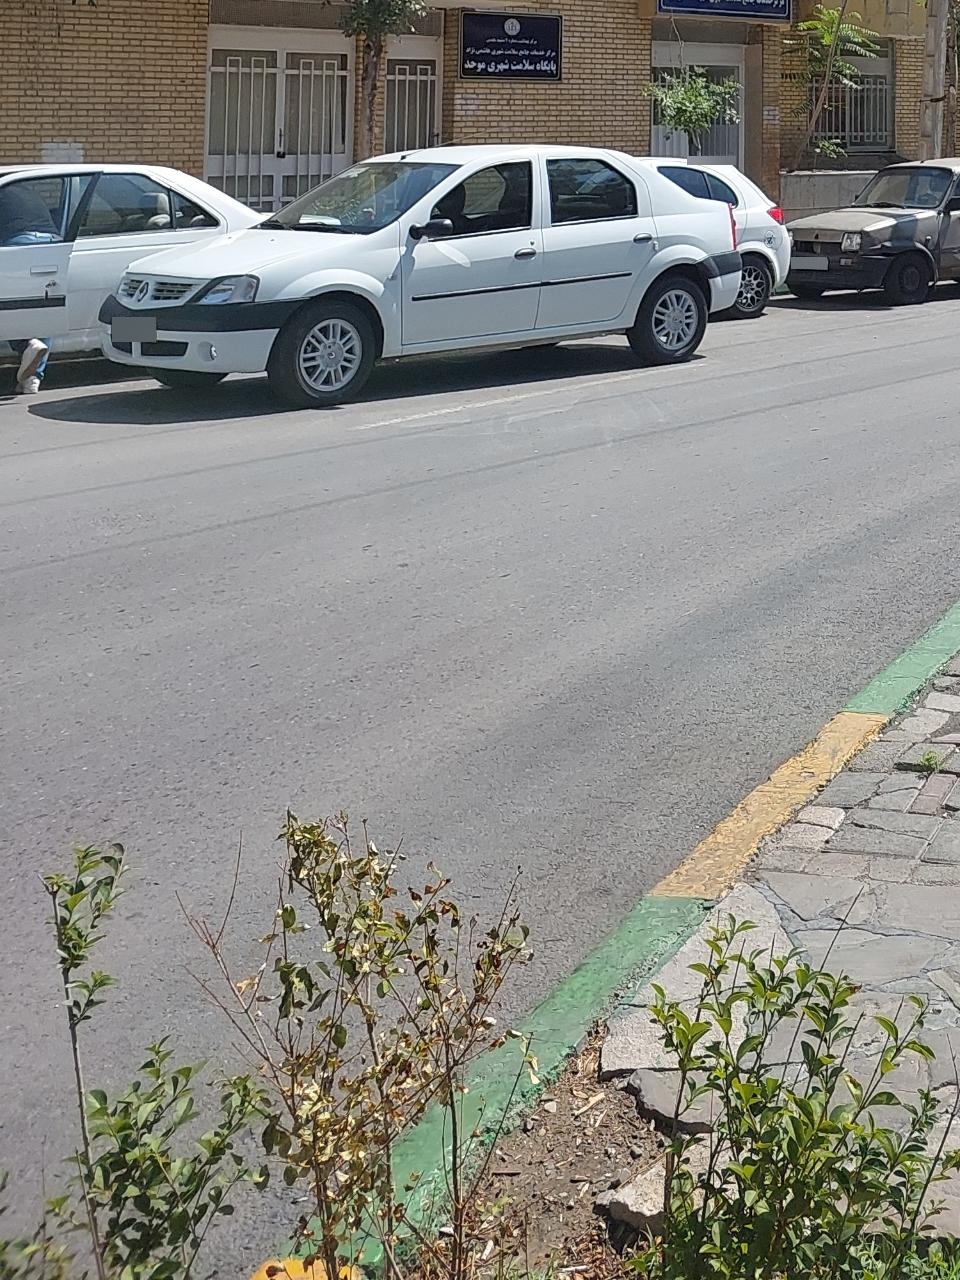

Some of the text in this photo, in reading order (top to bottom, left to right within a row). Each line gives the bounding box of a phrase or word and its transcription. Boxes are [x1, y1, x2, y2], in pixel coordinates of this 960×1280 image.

[491, 47, 504, 55] شهری
[545, 48, 556, 57] مرکز
[464, 58, 557, 75] پایگاه سلامت شهری موحد
